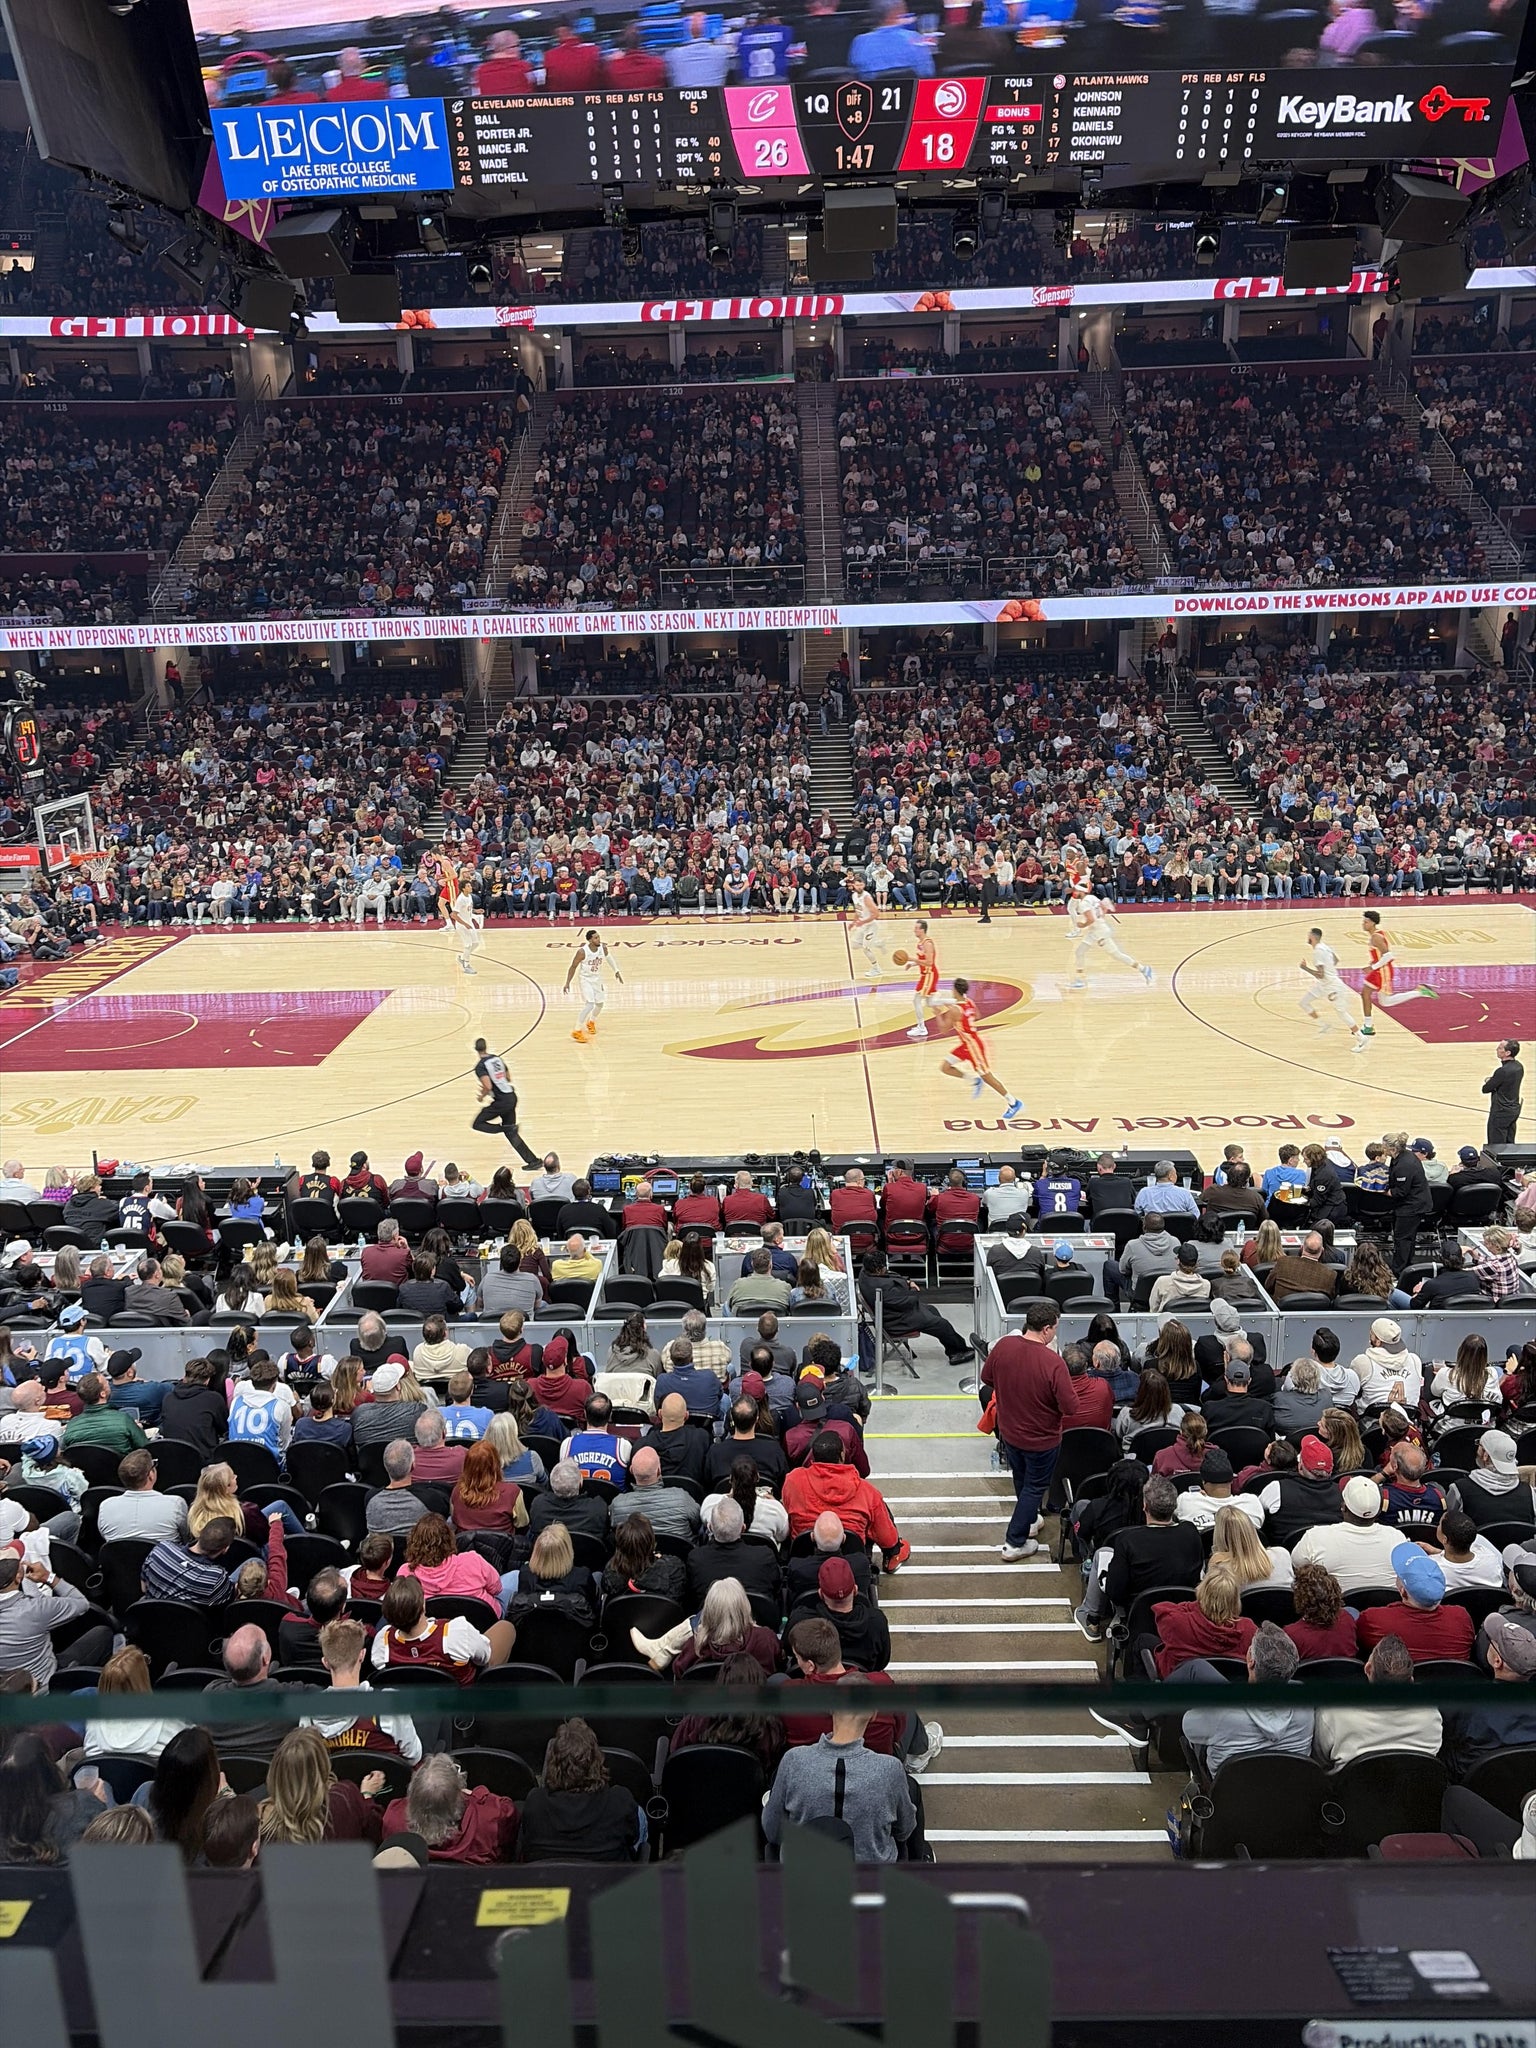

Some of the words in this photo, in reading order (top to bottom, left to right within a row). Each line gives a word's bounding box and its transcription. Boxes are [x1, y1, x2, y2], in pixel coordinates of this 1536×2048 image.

[1004, 78, 1033, 88] FOULS
[1073, 76, 1114, 86] ATLANTA
[1116, 75, 1149, 85] HAWKS
[1182, 74, 1198, 83] PTS
[1203, 73, 1221, 83] REB
[1226, 73, 1244, 82] AST
[1248, 73, 1266, 82] FLS
[471, 99, 525, 110] CLEVELAND
[526, 97, 574, 107] CAVALIERS
[585, 95, 601, 104] PTS
[606, 94, 624, 104] REB
[628, 94, 644, 103] AST
[648, 93, 664, 102] FLS
[679, 90, 708, 100] FOULS
[846, 94, 862, 106] DIFF
[881, 87, 901, 110] 21
[1013, 89, 1019, 102] 1
[1054, 93, 1059, 103] 1
[1074, 91, 1122, 102] JOHNSON
[1183, 90, 1190, 100] 7
[1205, 89, 1212, 100] 3
[1228, 89, 1234, 100] 1
[1252, 88, 1259, 99] 0
[690, 101, 698, 114] 5
[804, 94, 829, 114] 1Q
[997, 107, 1030, 117] BONUS
[1052, 108, 1059, 118] 3
[1073, 106, 1121, 117] KENNARD
[1181, 104, 1188, 115] 0
[1203, 104, 1211, 115] 0
[1225, 104, 1233, 114] 0
[1250, 103, 1257, 114] 0
[1277, 94, 1414, 129] KeyBank
[455, 117, 463, 127] 2
[474, 115, 500, 125] BALL
[586, 111, 593, 121] 8
[610, 110, 616, 120] 1
[632, 109, 639, 120] 0
[653, 109, 659, 119] 1
[846, 110, 862, 124] +8
[1051, 123, 1058, 133] 5
[1072, 121, 1113, 132] DANIELS
[1179, 119, 1187, 130] 0
[1201, 119, 1209, 130] 0
[1224, 119, 1231, 129] 0
[1248, 118, 1255, 129] 0
[222, 111, 440, 160] LECOM
[457, 132, 465, 142] 9
[476, 129, 515, 140] PORTER
[518, 128, 533, 138] JR.
[588, 126, 595, 136] 0
[612, 125, 617, 135] 1
[633, 124, 640, 134] 0
[653, 124, 660, 134] 0
[992, 126, 1004, 135] FG
[1022, 125, 1035, 135] 50
[456, 146, 469, 157] 22
[478, 144, 512, 155] NANCE
[513, 143, 528, 153] JR.
[589, 141, 596, 151] 0
[613, 140, 618, 150] 1
[634, 139, 640, 149] 0
[655, 138, 660, 148] 1
[675, 137, 688, 147] FG
[708, 137, 720, 147] 40
[921, 133, 954, 162] 18
[990, 141, 1007, 151] 3PT
[1021, 141, 1028, 150] 0
[1048, 137, 1060, 148] 17
[1071, 135, 1122, 147] OKONGWU
[1178, 134, 1185, 144] 0
[1200, 134, 1207, 144] 1
[1222, 133, 1228, 144] 1
[1246, 133, 1253, 143] 0
[676, 153, 693, 163] 3PT
[708, 152, 721, 163] 40
[754, 139, 788, 167] 26
[835, 144, 874, 169] 1:47
[990, 155, 1008, 164] TOL
[1025, 154, 1031, 165] 2
[1046, 152, 1059, 163] 27
[1070, 150, 1105, 161] KREJCI
[1176, 149, 1184, 159] 0
[1198, 148, 1206, 159] 0
[1220, 148, 1227, 158] 0
[1244, 147, 1251, 158] 0
[281, 165, 311, 178] LAKE
[313, 163, 338, 176] ERIE
[340, 161, 391, 174] COLLEGE
[458, 161, 471, 171] 32
[479, 159, 508, 169] WADE
[590, 155, 597, 166] 0
[614, 155, 620, 165] 2
[635, 154, 640, 164] 1
[656, 153, 661, 163] 1
[460, 175, 473, 185] 45
[481, 173, 528, 184] MITCHELL
[591, 170, 598, 180] 9
[615, 169, 621, 179] 0
[636, 168, 642, 178] 1
[656, 167, 662, 178] 1
[677, 167, 695, 177] TOL
[713, 166, 720, 176] 2
[262, 180, 278, 193] OF
[280, 176, 360, 191] OSTEOPATHIC
[361, 173, 417, 188] MEDICINE
[1032, 286, 1075, 305] Swensons
[496, 306, 537, 325] Swensons
[1174, 597, 1270, 612] DOWNLOAD
[1273, 595, 1301, 609] THE
[1305, 592, 1391, 608] SWENSONS
[1395, 591, 1428, 605] APP
[1431, 590, 1467, 604] AND
[1471, 588, 1500, 602] USE
[7, 631, 44, 648] WHEN
[49, 630, 72, 648] ANY
[77, 628, 135, 647] OPPOSING
[139, 626, 181, 645] PLAYER
[185, 625, 228, 643] MISSES
[231, 625, 256, 642] TWO
[260, 621, 338, 641] CONSECUTIVE
[341, 621, 369, 638] FREE
[372, 620, 420, 637] THROWS
[424, 618, 467, 636] DURING
[472, 618, 479, 634] A
[483, 617, 545, 635] CAVALIERS
[549, 615, 580, 633] HOME
[584, 615, 616, 632] GAME
[620, 614, 646, 631] THIS
[650, 612, 700, 630] SEASON.
[704, 611, 734, 629] NEXT
[738, 610, 760, 628] DAY
[765, 608, 842, 627] REDEMPTION.
[0, 1095, 200, 1130] CAVS
[943, 1117, 1100, 1133] Arena
[1113, 1114, 1308, 1132] Rocket
[1048, 1182, 1072, 1190] JACKSON
[1054, 1192, 1067, 1212] 8
[123, 1216, 143, 1229] 45
[1387, 1381, 1407, 1404] 4
[234, 1405, 269, 1435] 10
[1397, 1510, 1435, 1524] JAMES
